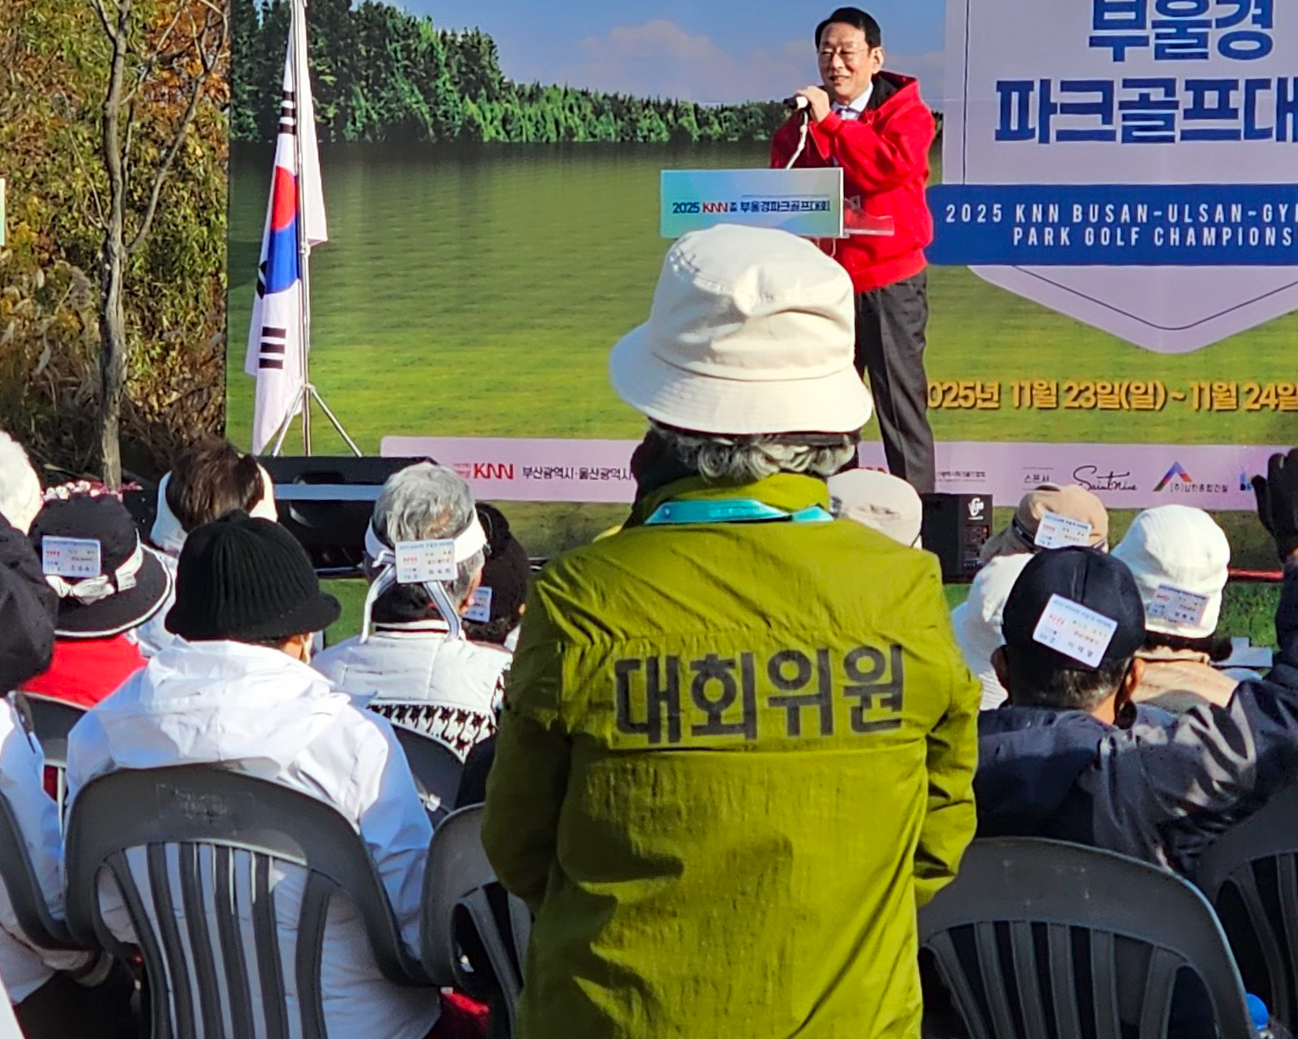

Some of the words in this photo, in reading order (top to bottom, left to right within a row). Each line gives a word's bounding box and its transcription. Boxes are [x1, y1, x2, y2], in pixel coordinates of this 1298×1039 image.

[672, 202, 700, 214] 2025
[945, 203, 1003, 224] 2025
[1015, 203, 1061, 223] KNN
[1012, 226, 1071, 247] PARK
[1084, 226, 1141, 247] GOLF
[927, 379, 1001, 409] 025년
[1010, 380, 1058, 410] 11월
[1190, 381, 1239, 411] 11월
[474, 462, 514, 480] KNN
[613, 644, 904, 745] 대회위원
